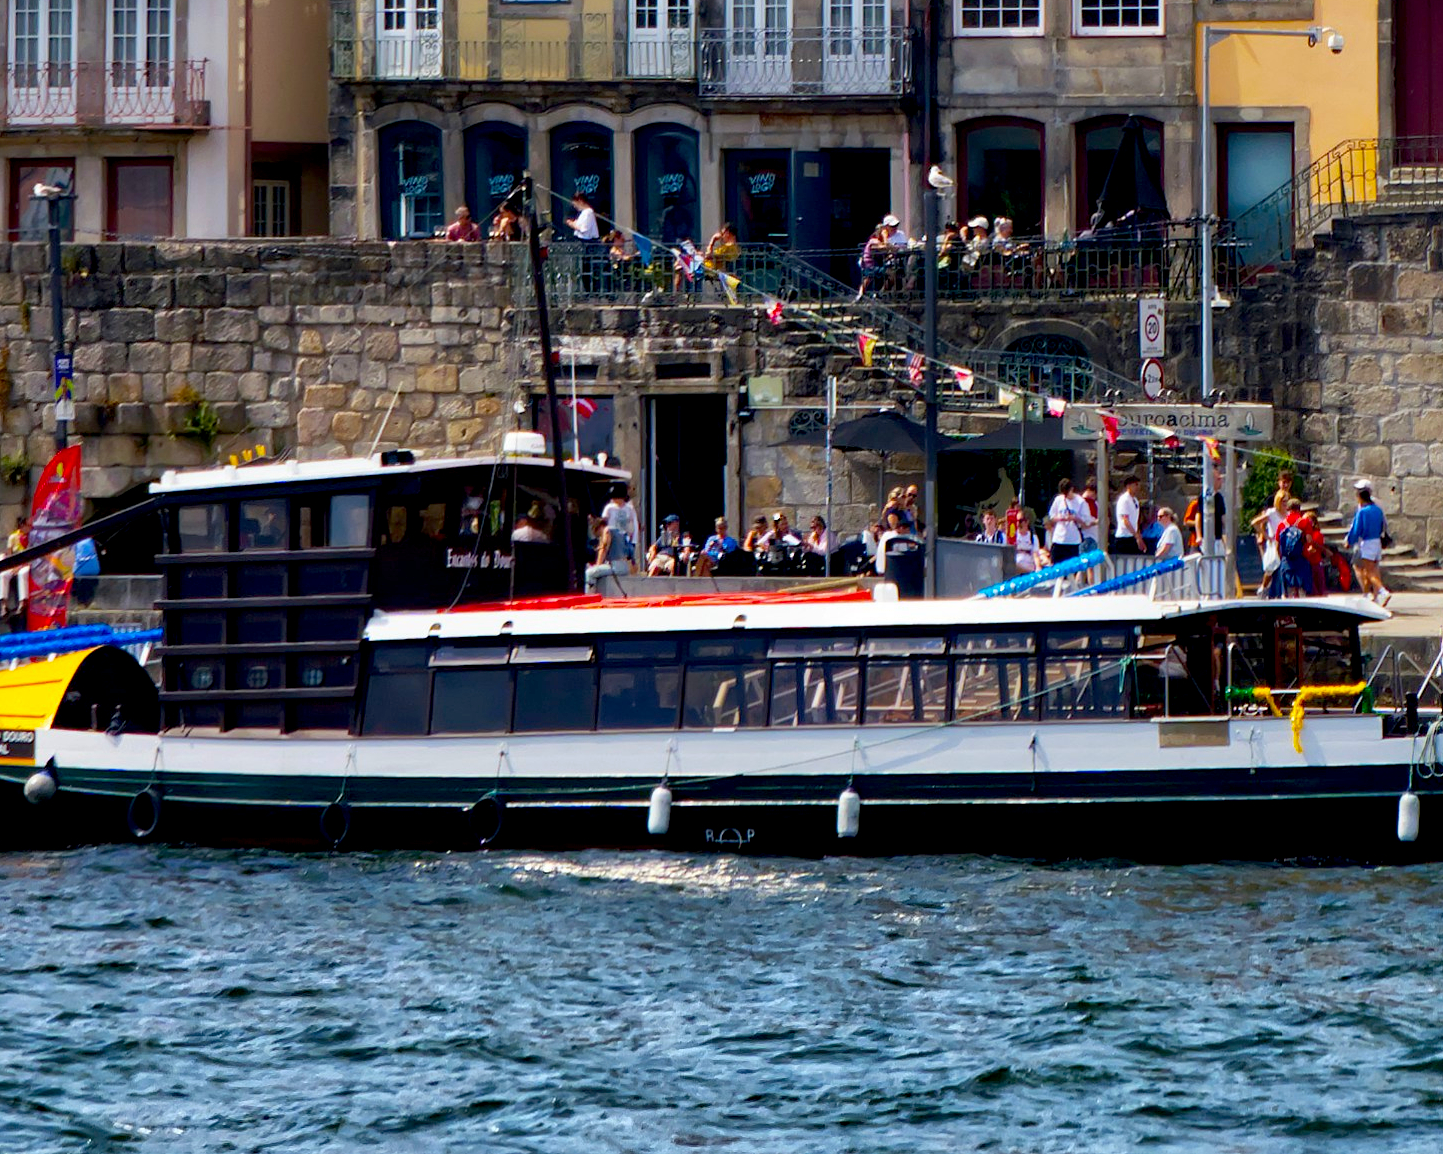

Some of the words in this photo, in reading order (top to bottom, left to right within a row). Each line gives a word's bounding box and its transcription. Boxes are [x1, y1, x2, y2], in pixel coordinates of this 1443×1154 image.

[1148, 321, 1158, 335] 20
[1118, 411, 1230, 428] ouroacima
[3, 730, 34, 743] DOURO
[705, 828, 714, 842] R
[747, 828, 755, 842] P
